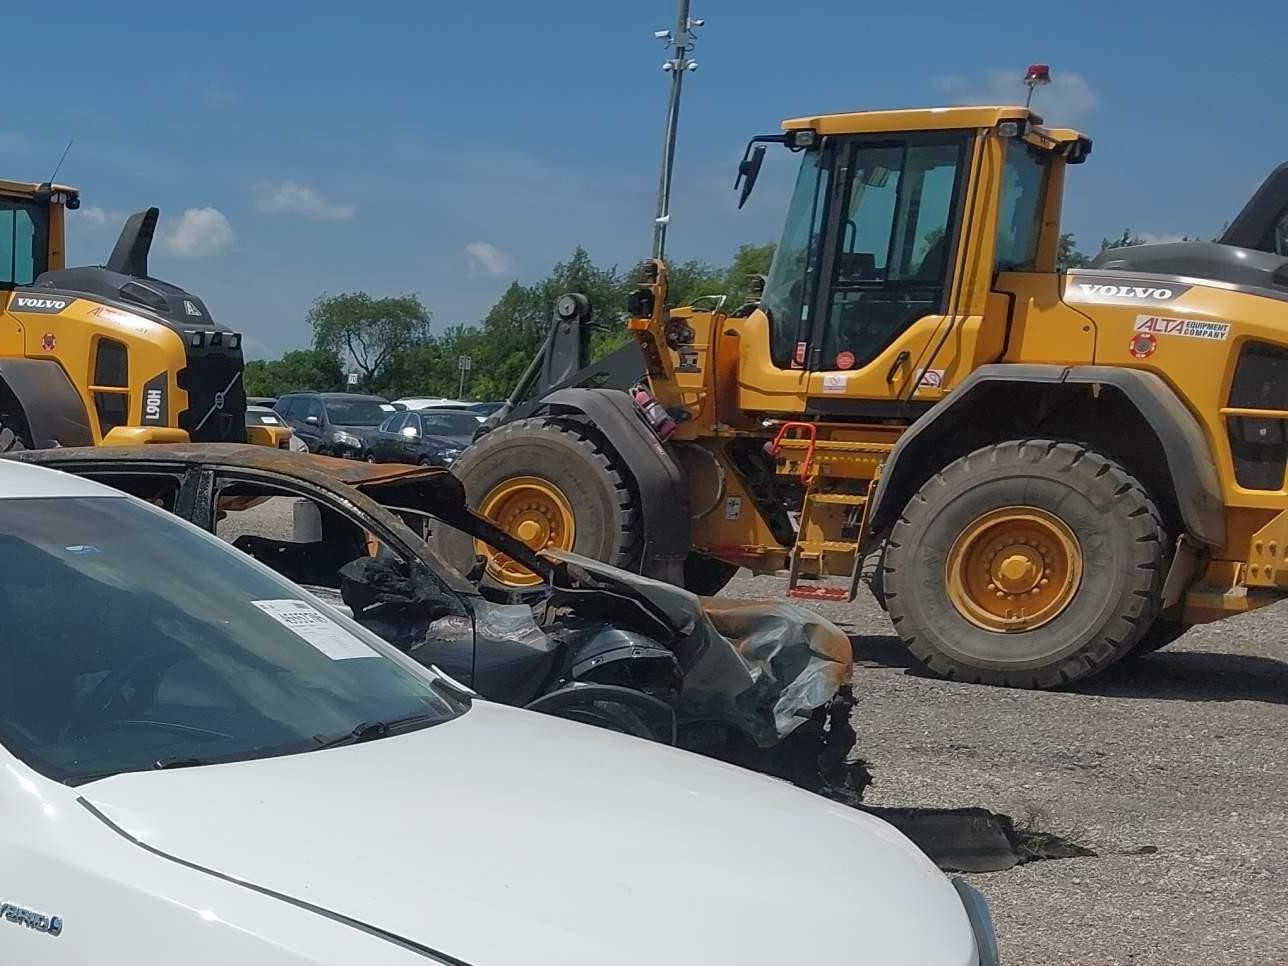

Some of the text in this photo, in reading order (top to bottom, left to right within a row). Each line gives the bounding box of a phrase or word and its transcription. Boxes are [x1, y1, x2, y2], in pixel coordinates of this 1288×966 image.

[1079, 284, 1173, 300] VOLVO
[17, 297, 66, 309] VOLVO
[1136, 317, 1185, 334] ALTA
[1186, 321, 1228, 331] EQUIPMENT
[1184, 329, 1226, 339] COMPANY
[145, 389, 162, 420] L90H
